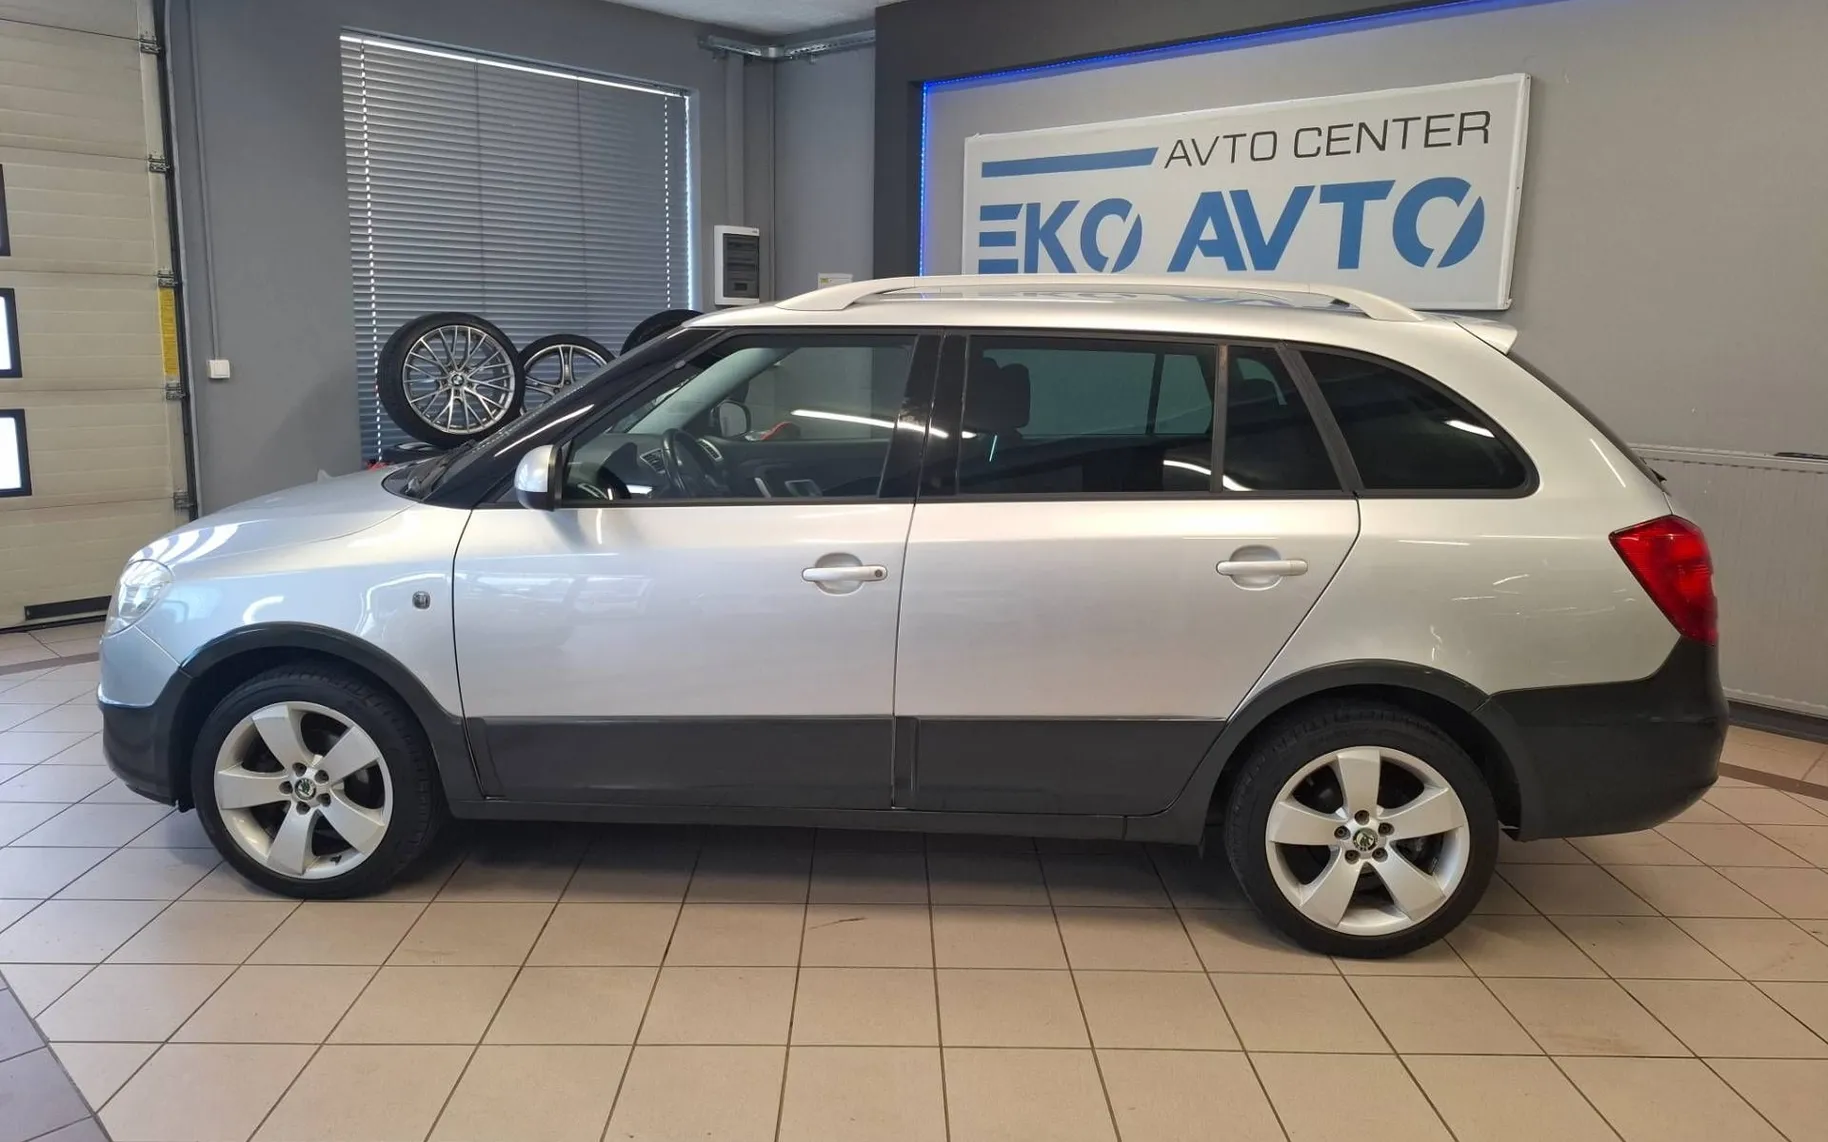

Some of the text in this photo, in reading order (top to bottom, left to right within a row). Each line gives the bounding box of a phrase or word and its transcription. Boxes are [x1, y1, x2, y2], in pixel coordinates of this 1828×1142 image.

[1164, 110, 1491, 169] AVTO CENTER
[978, 176, 1485, 274] EKO AVTO
